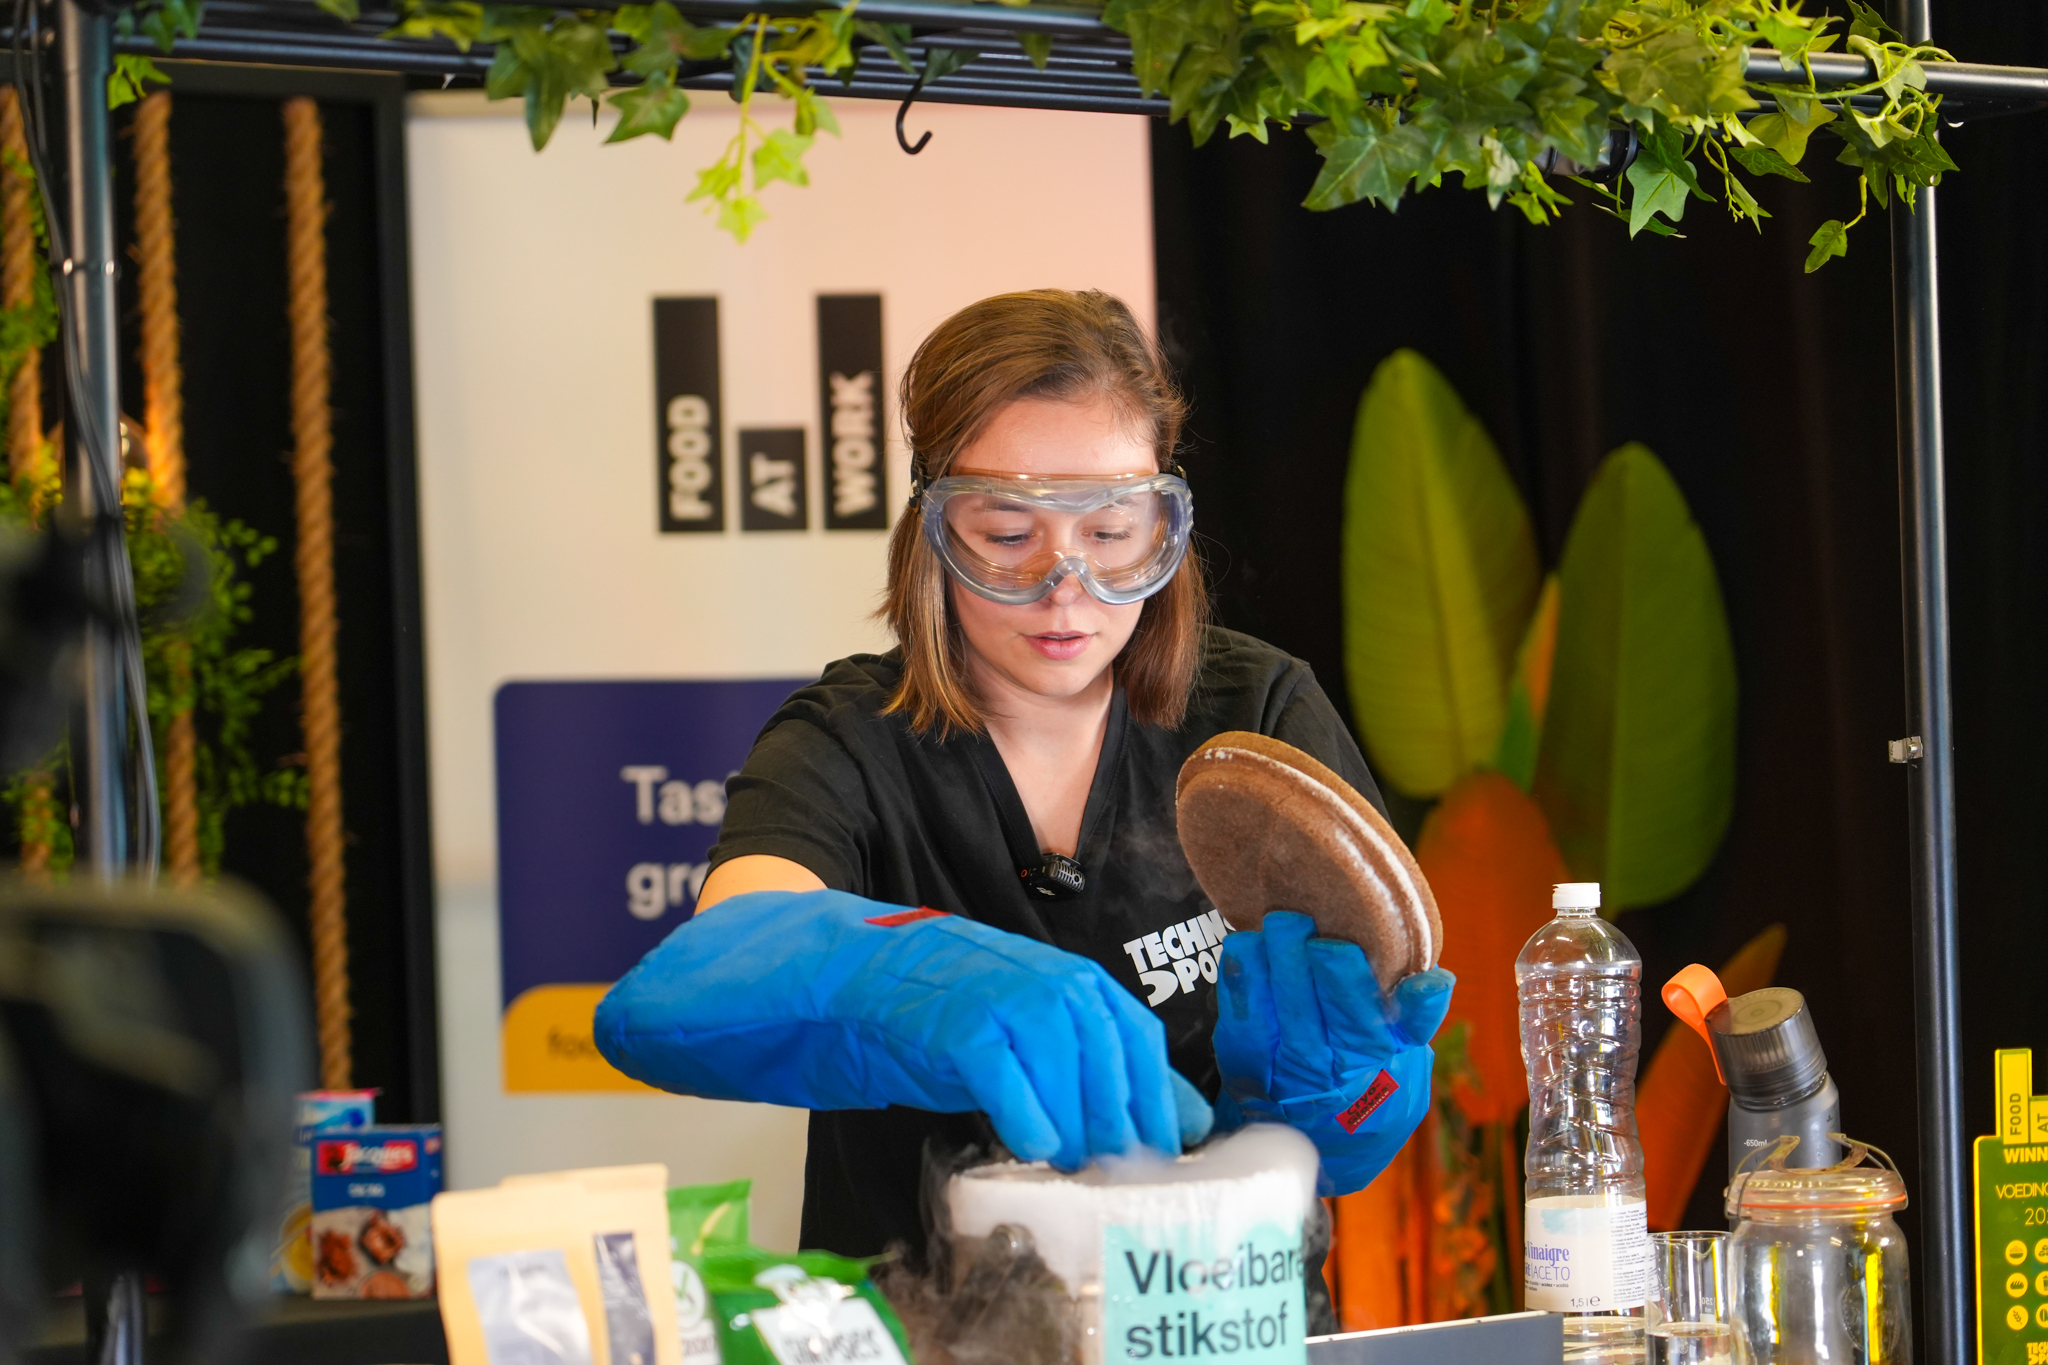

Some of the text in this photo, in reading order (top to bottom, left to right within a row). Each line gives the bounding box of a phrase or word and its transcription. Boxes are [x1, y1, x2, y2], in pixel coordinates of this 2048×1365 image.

[667, 394, 712, 520] FOOD
[829, 369, 876, 518] WORK
[751, 452, 796, 519] AT
[620, 765, 738, 825] Tas
[2010, 1093, 2021, 1135] FOOD
[2037, 1113, 2048, 1133] AT
[2025, 1207, 2048, 1225] 20
[1533, 1265, 1570, 1281] ACETO
[1125, 1301, 1288, 1359] stikstof
